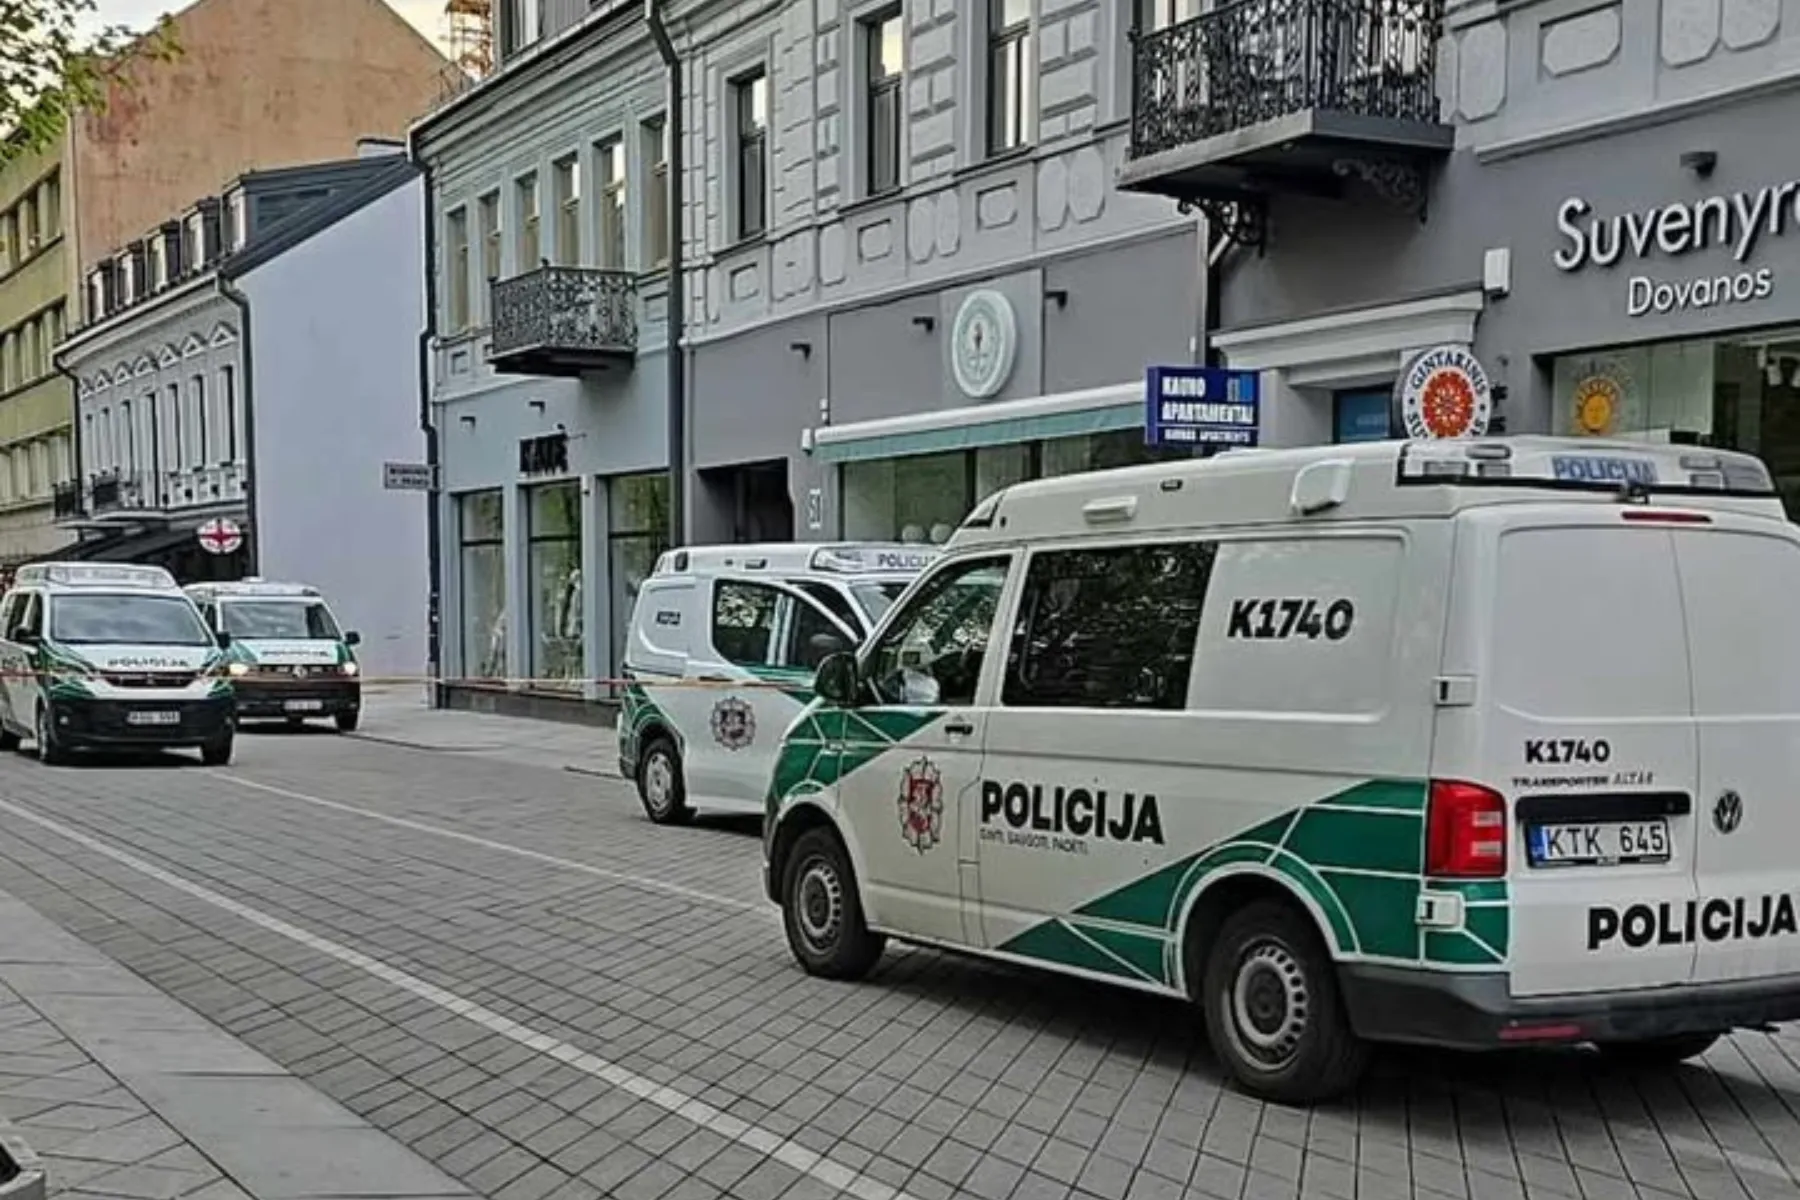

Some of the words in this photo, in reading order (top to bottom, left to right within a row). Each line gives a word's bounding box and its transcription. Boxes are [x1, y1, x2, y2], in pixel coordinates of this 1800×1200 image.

[1554, 180, 1800, 271] Suvenyr
[1627, 268, 1773, 316] Dovanos
[1552, 456, 1658, 483] POLICIJA
[1227, 599, 1354, 640] K1740
[1525, 740, 1610, 763] K1740
[981, 780, 1165, 845] POLICIJA
[1547, 827, 1602, 856] KTK
[1619, 825, 1664, 852] 645
[1587, 893, 1798, 950] POLICIJA
